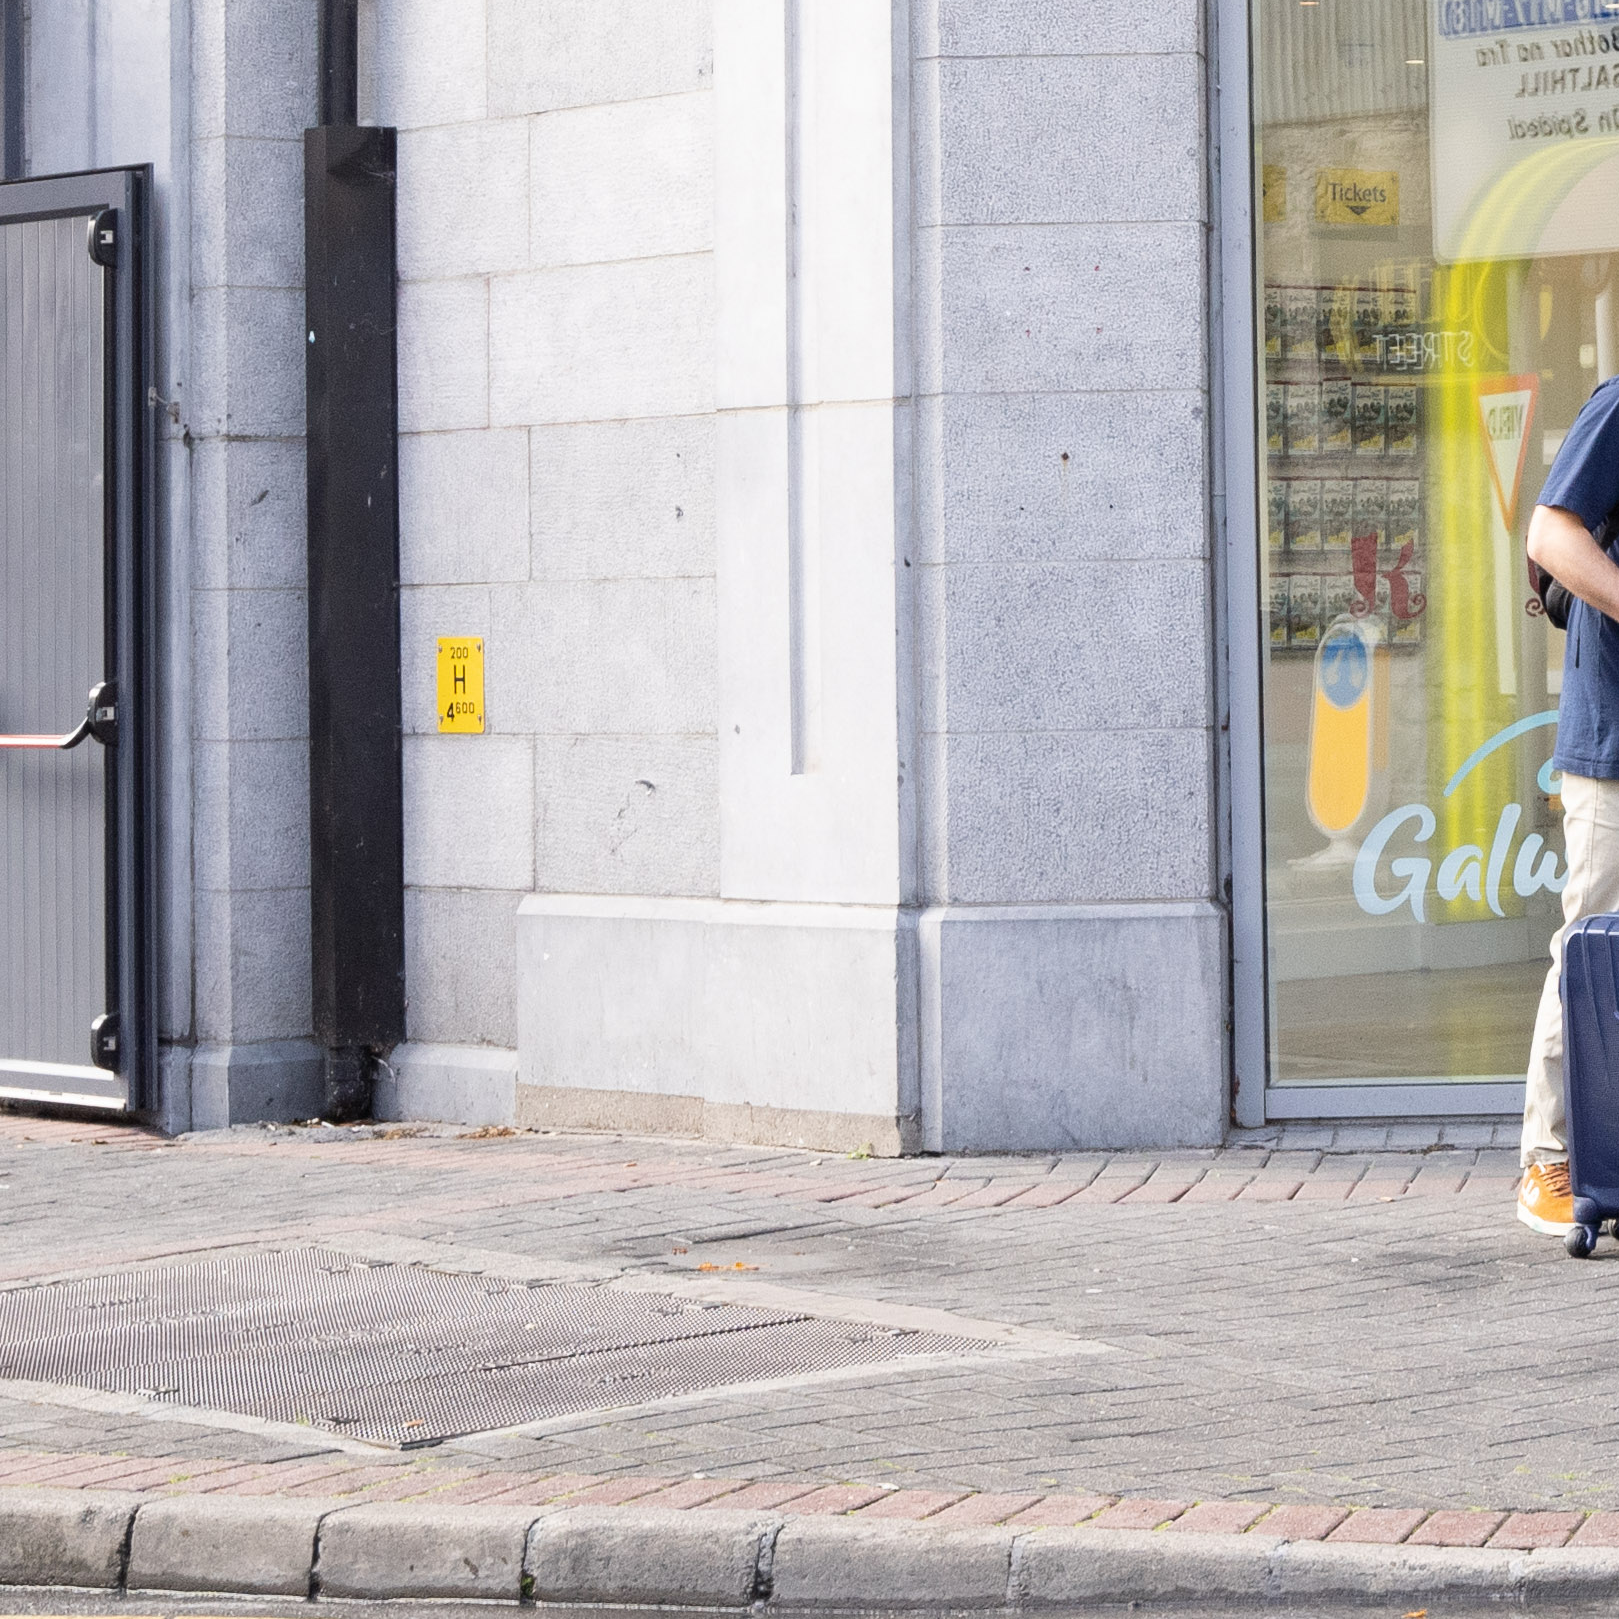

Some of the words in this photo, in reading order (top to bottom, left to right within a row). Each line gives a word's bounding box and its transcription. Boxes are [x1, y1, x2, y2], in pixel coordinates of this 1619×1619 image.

[1328, 182, 1387, 203] Tickets
[450, 646, 469, 660] 200
[453, 664, 466, 695] H
[1352, 802, 1571, 924] Galw
